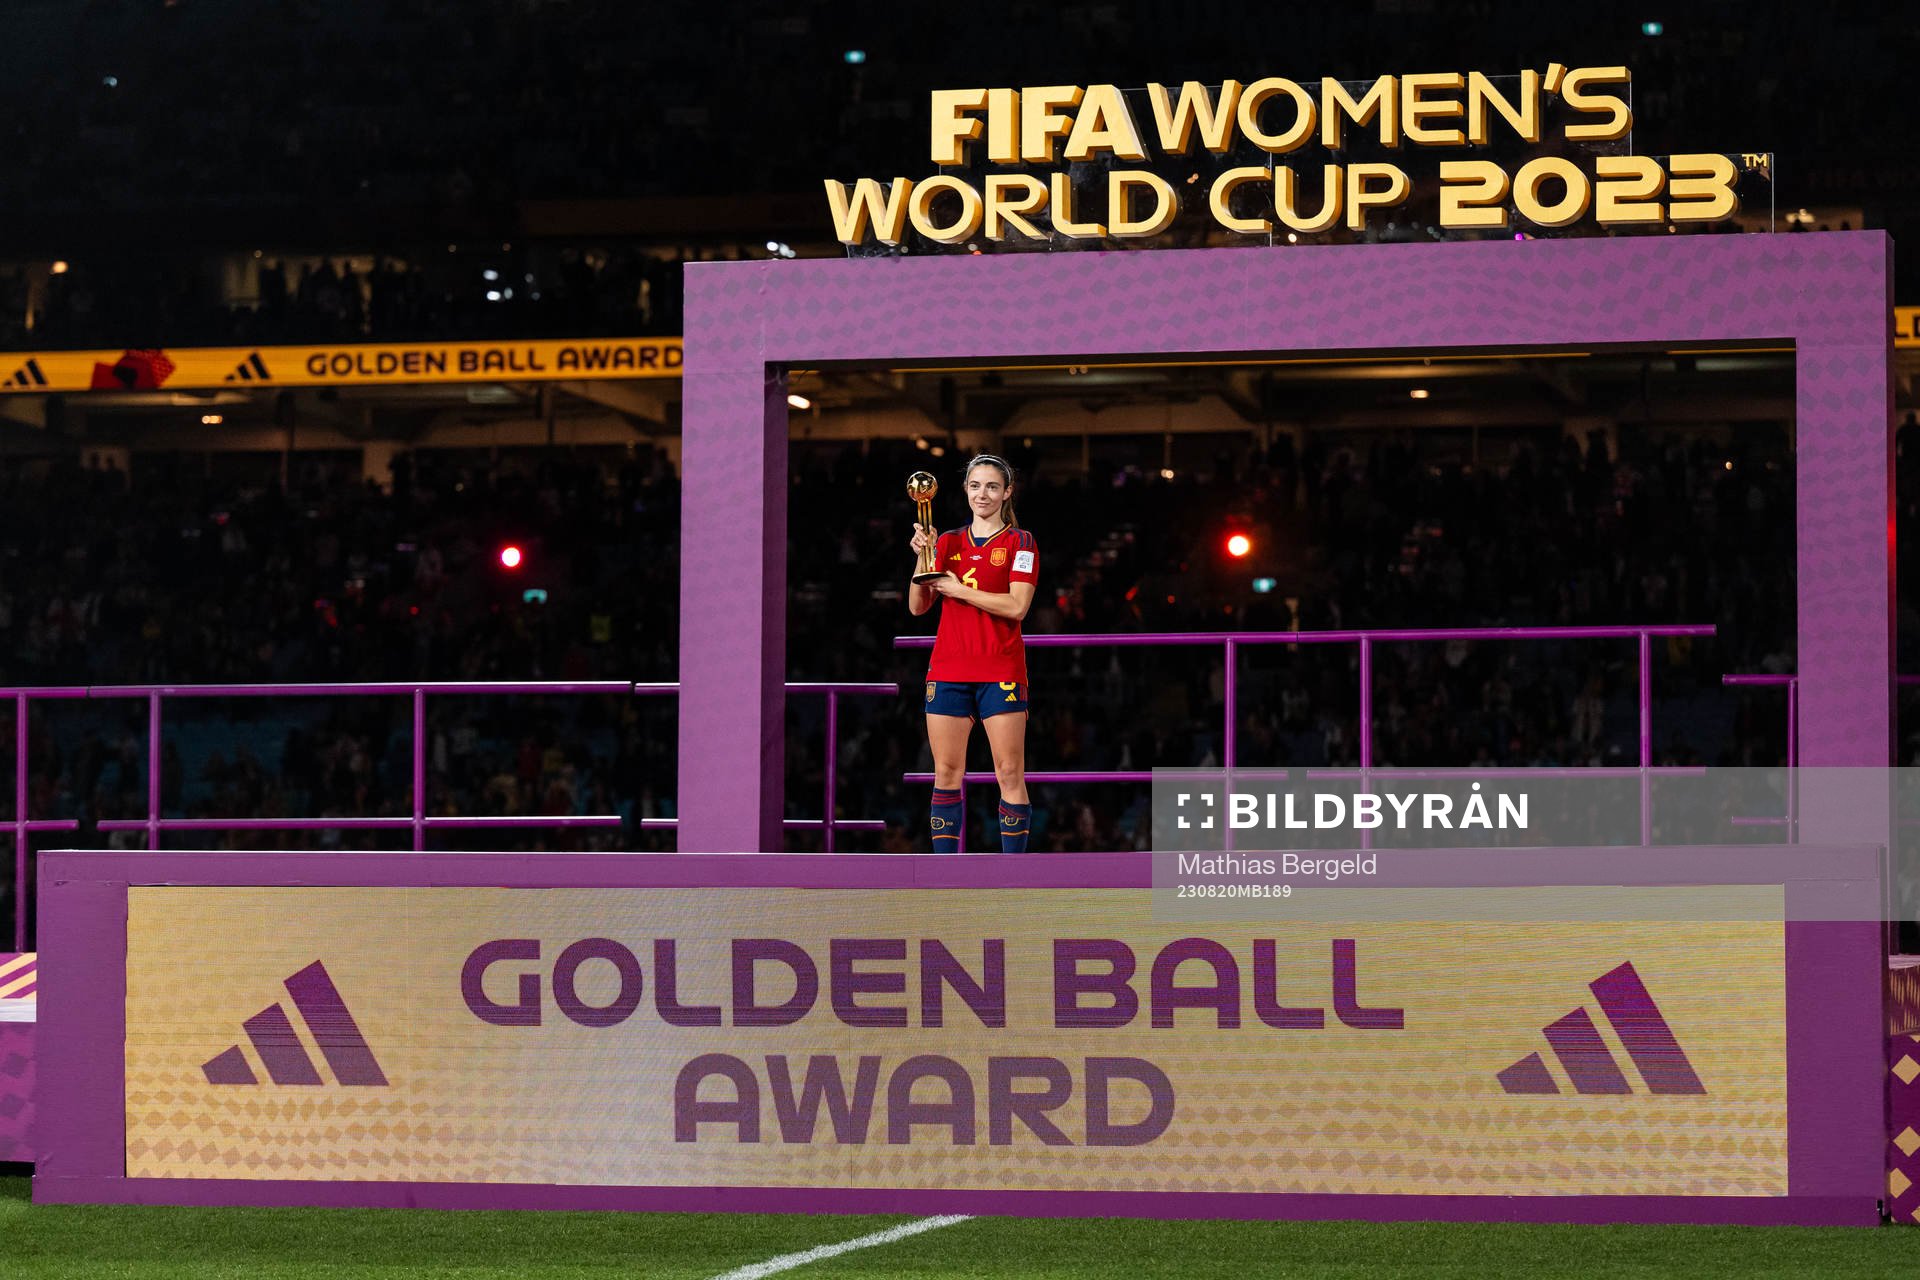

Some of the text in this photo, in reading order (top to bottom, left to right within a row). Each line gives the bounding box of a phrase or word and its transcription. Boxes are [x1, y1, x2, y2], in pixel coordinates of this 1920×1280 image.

[931, 62, 1632, 165] FIFA WOMEN'S
[824, 170, 1181, 246] WORLD
[1210, 161, 1410, 235] CUP
[1439, 153, 1738, 230] 2023
[306, 345, 683, 376] GOLDEN BALL AWARD
[461, 938, 1404, 1029] GOLDEN BALL
[673, 1052, 1176, 1146] AWARD
